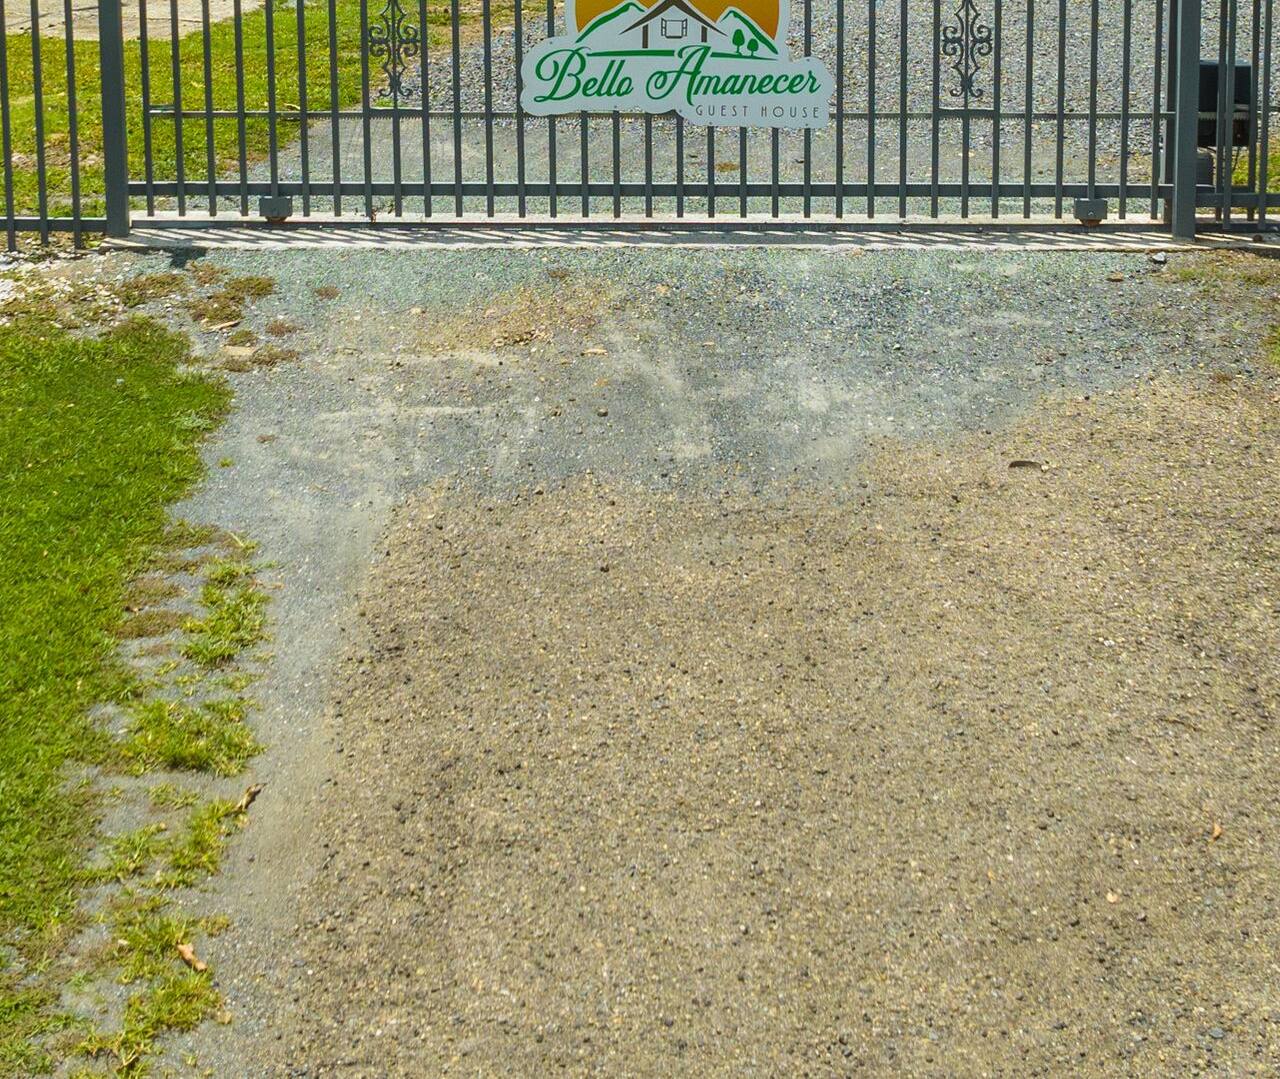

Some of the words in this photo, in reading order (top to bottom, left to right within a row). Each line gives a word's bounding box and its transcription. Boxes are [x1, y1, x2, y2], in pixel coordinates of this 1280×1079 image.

[533, 45, 634, 103] Bello
[646, 44, 821, 106] Amanecer
[695, 104, 749, 117] GUEST
[760, 105, 820, 119] HOUSE
